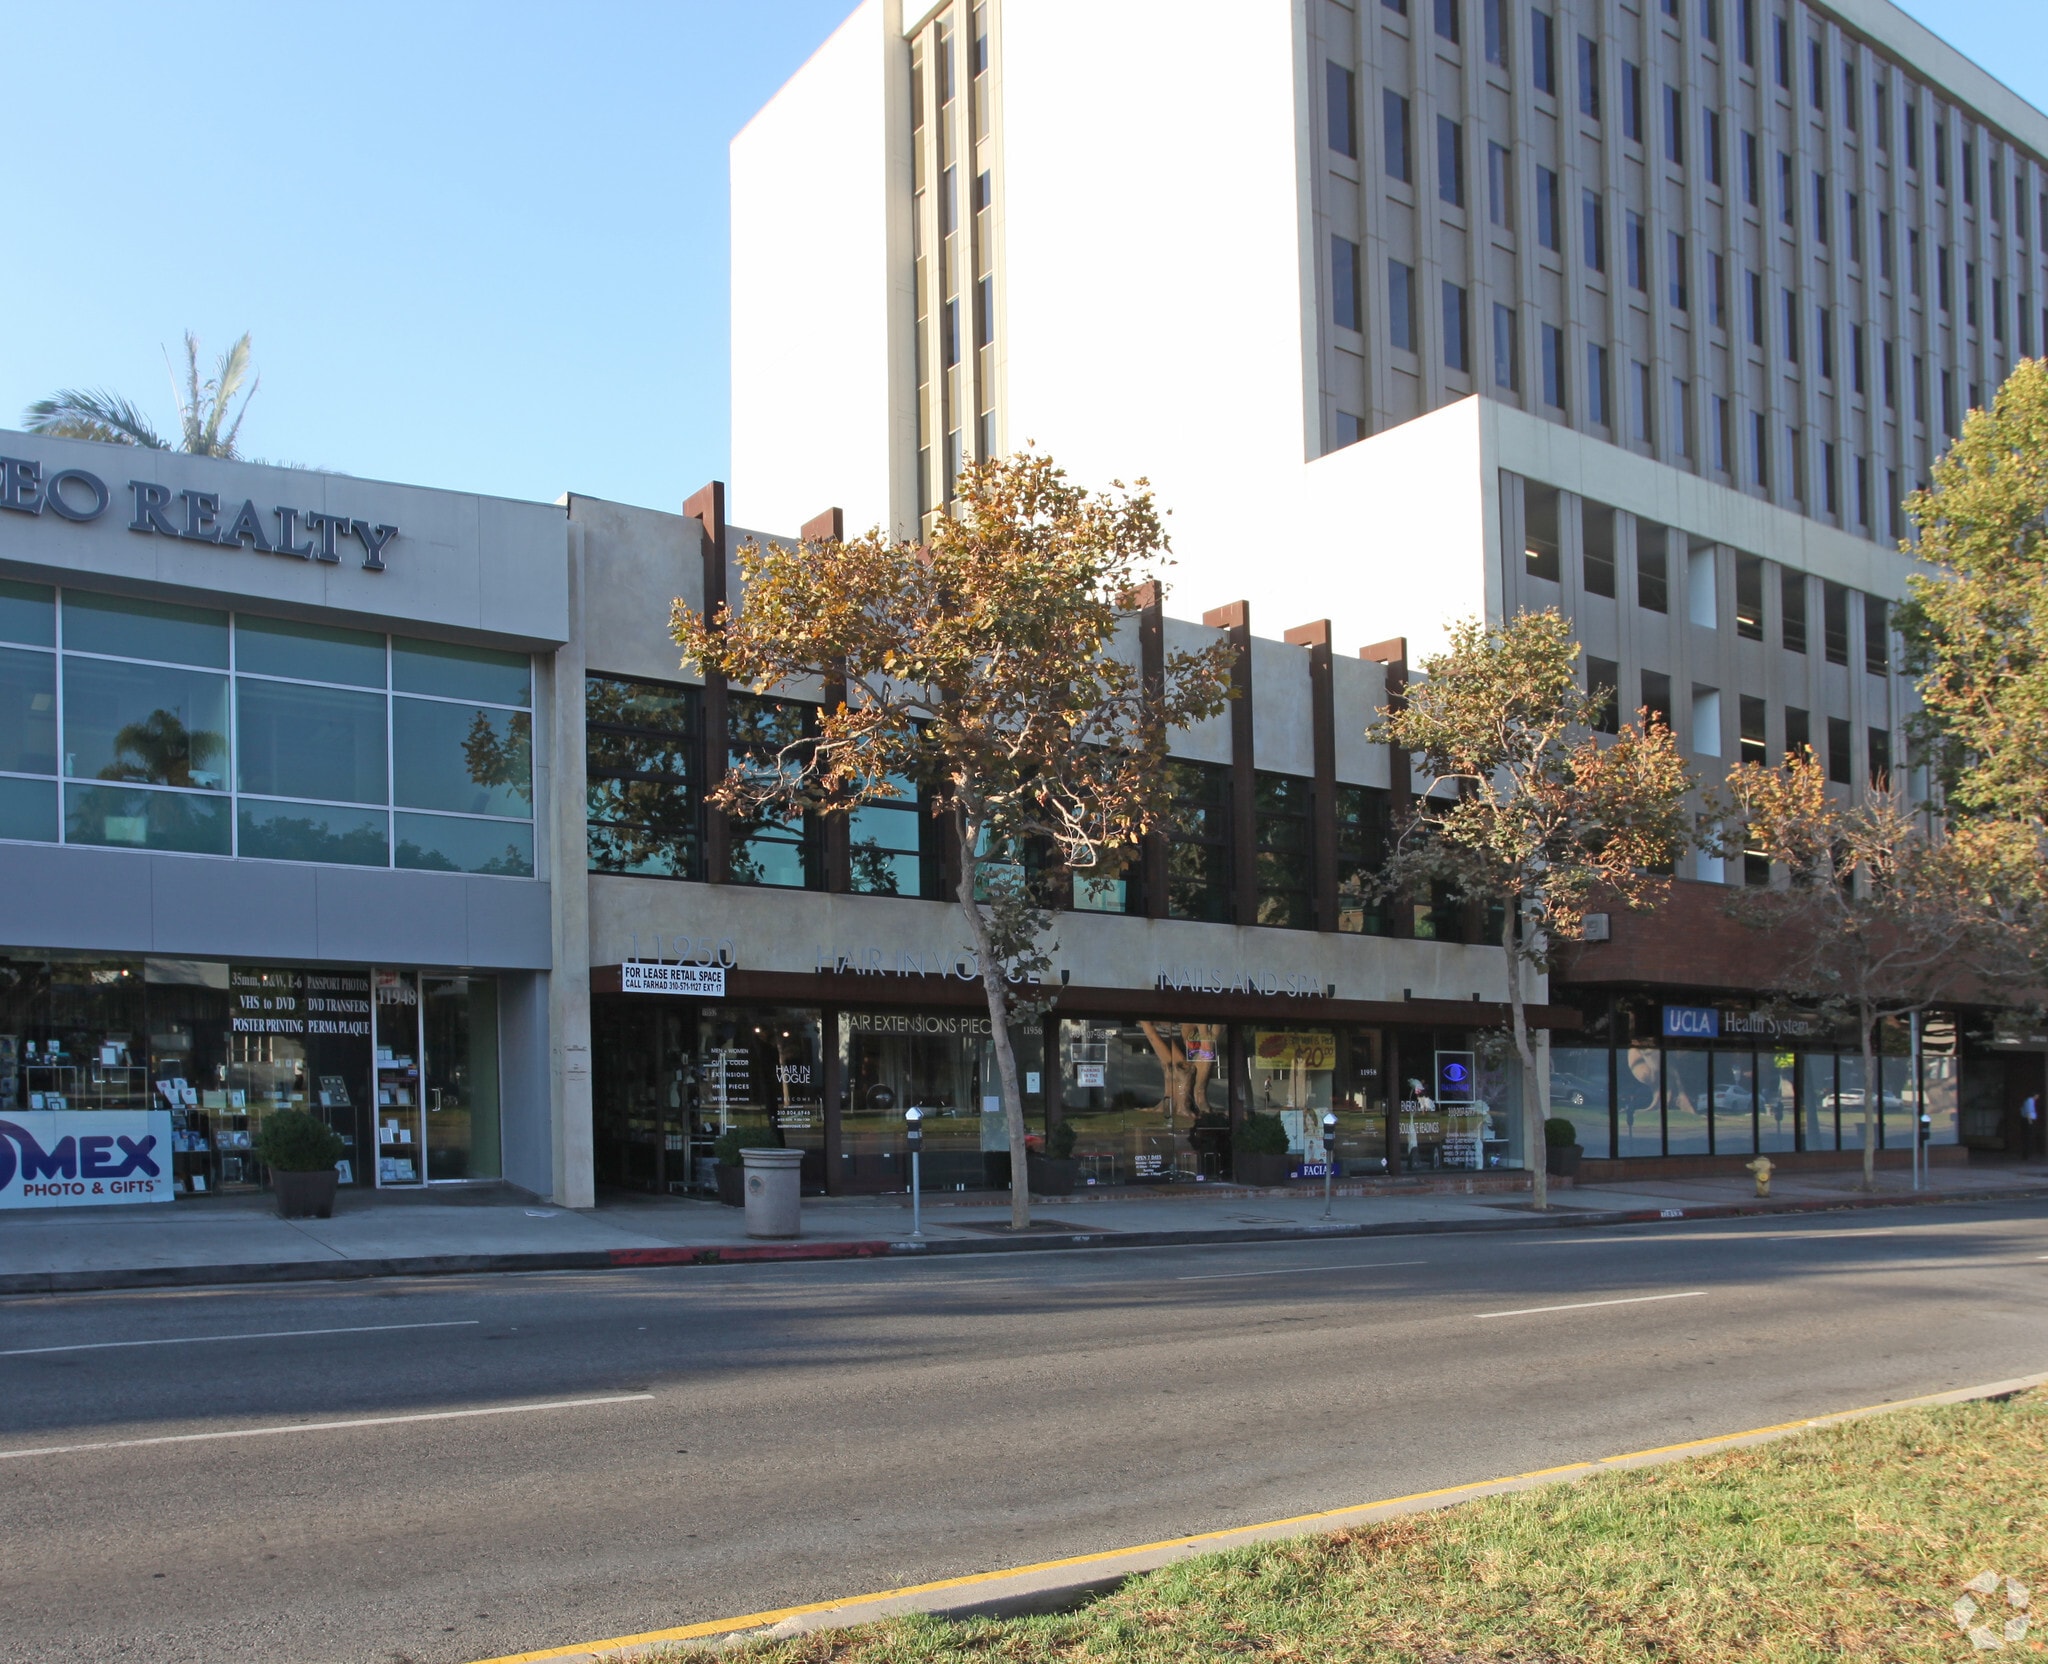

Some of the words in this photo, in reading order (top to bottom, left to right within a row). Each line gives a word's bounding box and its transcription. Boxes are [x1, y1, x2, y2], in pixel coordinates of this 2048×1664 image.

[128, 480, 400, 571] REALTY
[632, 932, 737, 969] 11950
[816, 945, 886, 977] HAIR
[896, 949, 926, 978] IN
[231, 971, 261, 989] 35mm,
[625, 966, 641, 979] FOR
[643, 968, 668, 980] LEASE
[670, 969, 697, 981] RETAIL
[699, 970, 722, 982] SPACE
[1158, 965, 1223, 994] NAILS
[1230, 969, 1278, 996] AND
[1286, 972, 1323, 999] SPA
[307, 976, 340, 991] PASSPORT
[341, 977, 369, 992] PHOTOS
[625, 978, 642, 989] CALL
[643, 979, 668, 990] FARHAD
[703, 983, 714, 992] EXT
[716, 983, 722, 993] 17
[239, 995, 260, 1009] VHS
[263, 997, 272, 1010] to
[276, 996, 296, 1010] DVD
[308, 997, 325, 1012] DVD
[325, 998, 370, 1013] TRANSFERS
[378, 988, 418, 1006] 11948
[232, 1017, 265, 1032] POSTER
[266, 1019, 304, 1033] PRINTING
[308, 1019, 338, 1033] PERMA
[338, 1020, 370, 1037] PLAQUE
[874, 1015, 957, 1033] EXTENSIONS
[1670, 1010, 1711, 1033] UCLA
[1724, 1011, 1765, 1033] Health
[1767, 1014, 1809, 1040] System
[1023, 1026, 1043, 1036] 11956
[775, 1064, 798, 1075] HAIR
[800, 1065, 811, 1075] IN
[776, 1073, 811, 1084] VOGUE
[23, 1182, 86, 1198] PHOTO
[91, 1181, 105, 1195] &
